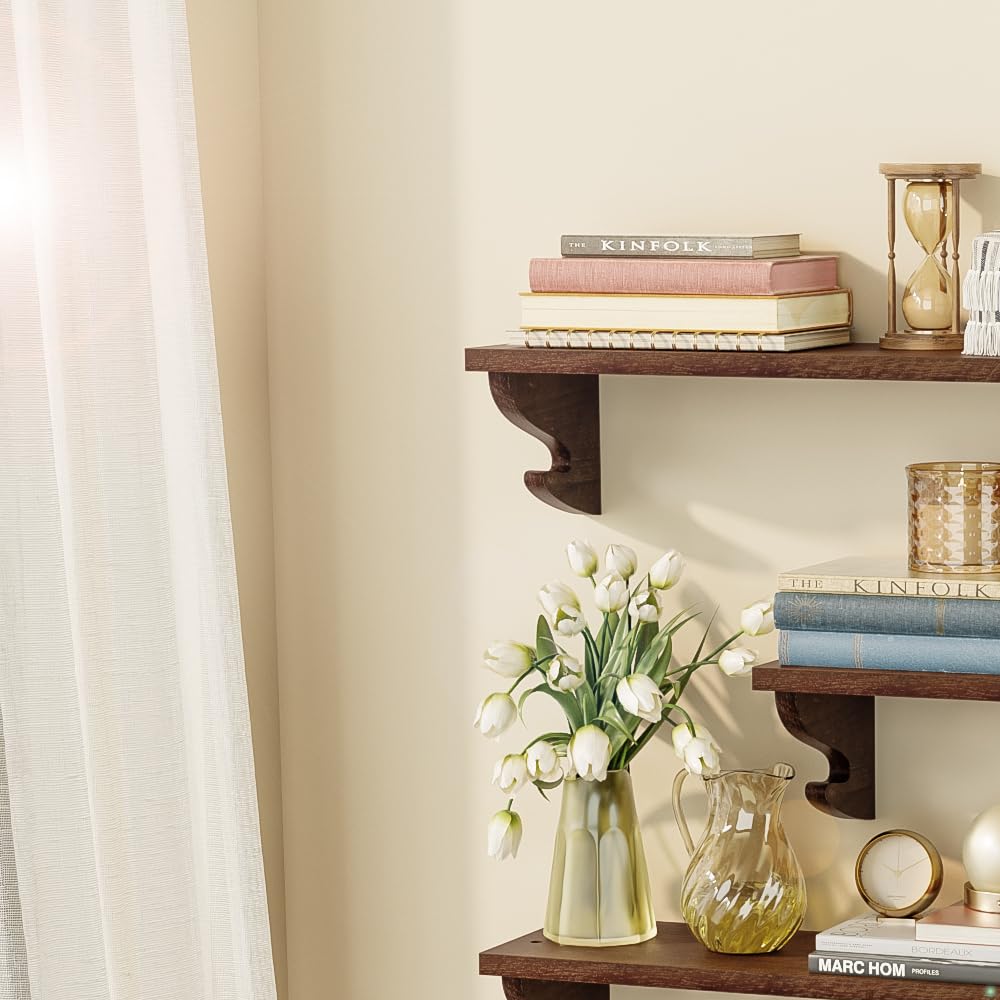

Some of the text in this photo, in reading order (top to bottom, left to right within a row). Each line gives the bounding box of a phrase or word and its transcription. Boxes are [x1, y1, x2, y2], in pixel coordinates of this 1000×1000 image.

[601, 239, 713, 252] KINFOLK
[791, 579, 823, 588] THE
[854, 579, 991, 598] KINFOLK
[911, 945, 973, 957] BORDEAUX
[818, 958, 940, 977] MARC HOM PROFILES
